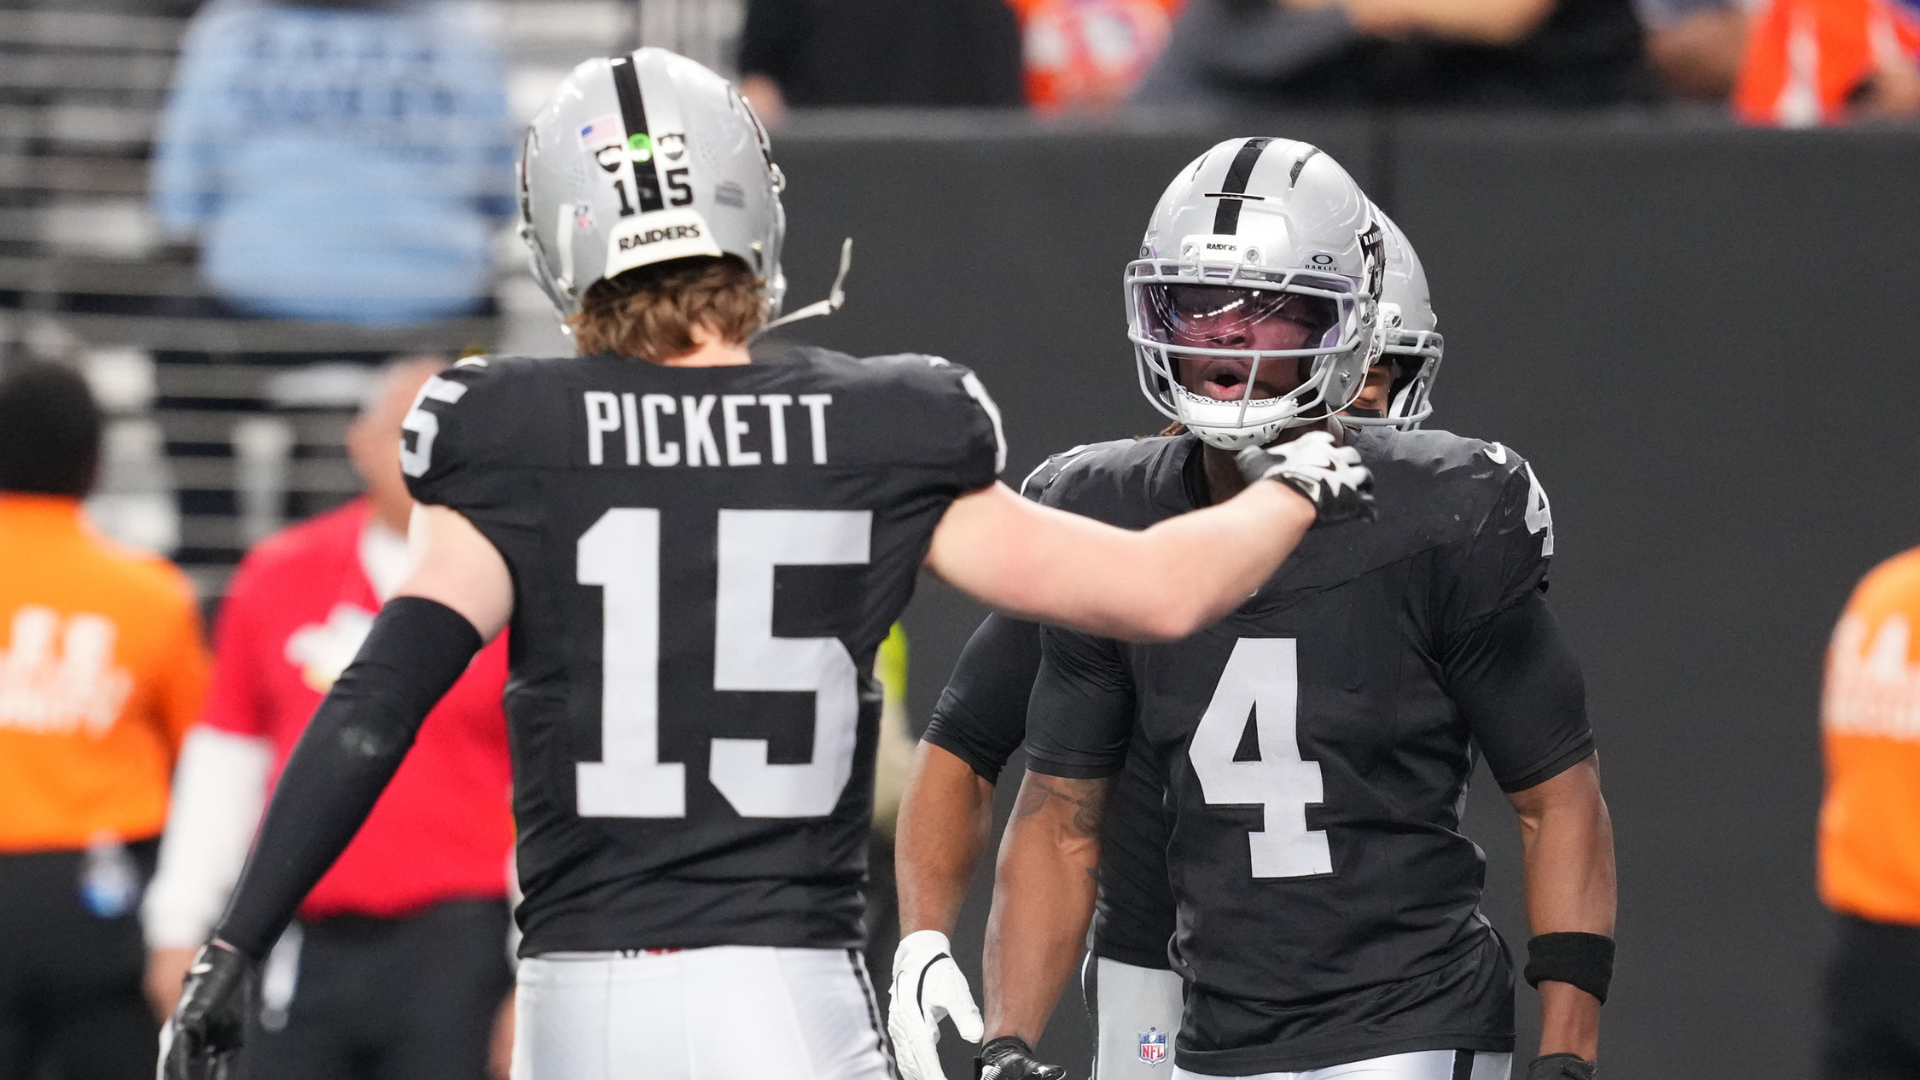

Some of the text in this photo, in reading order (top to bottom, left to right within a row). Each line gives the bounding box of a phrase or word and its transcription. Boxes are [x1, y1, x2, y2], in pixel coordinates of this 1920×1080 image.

[618, 224, 700, 252] RAIDERS
[1206, 242, 1237, 251] RAIDERS
[1305, 264, 1338, 272] OAKLEY
[583, 391, 833, 467] PICKETT
[1524, 461, 1554, 557] 4
[576, 507, 873, 818] 15
[1188, 637, 1333, 879] 4
[1142, 1044, 1164, 1060] NFL
